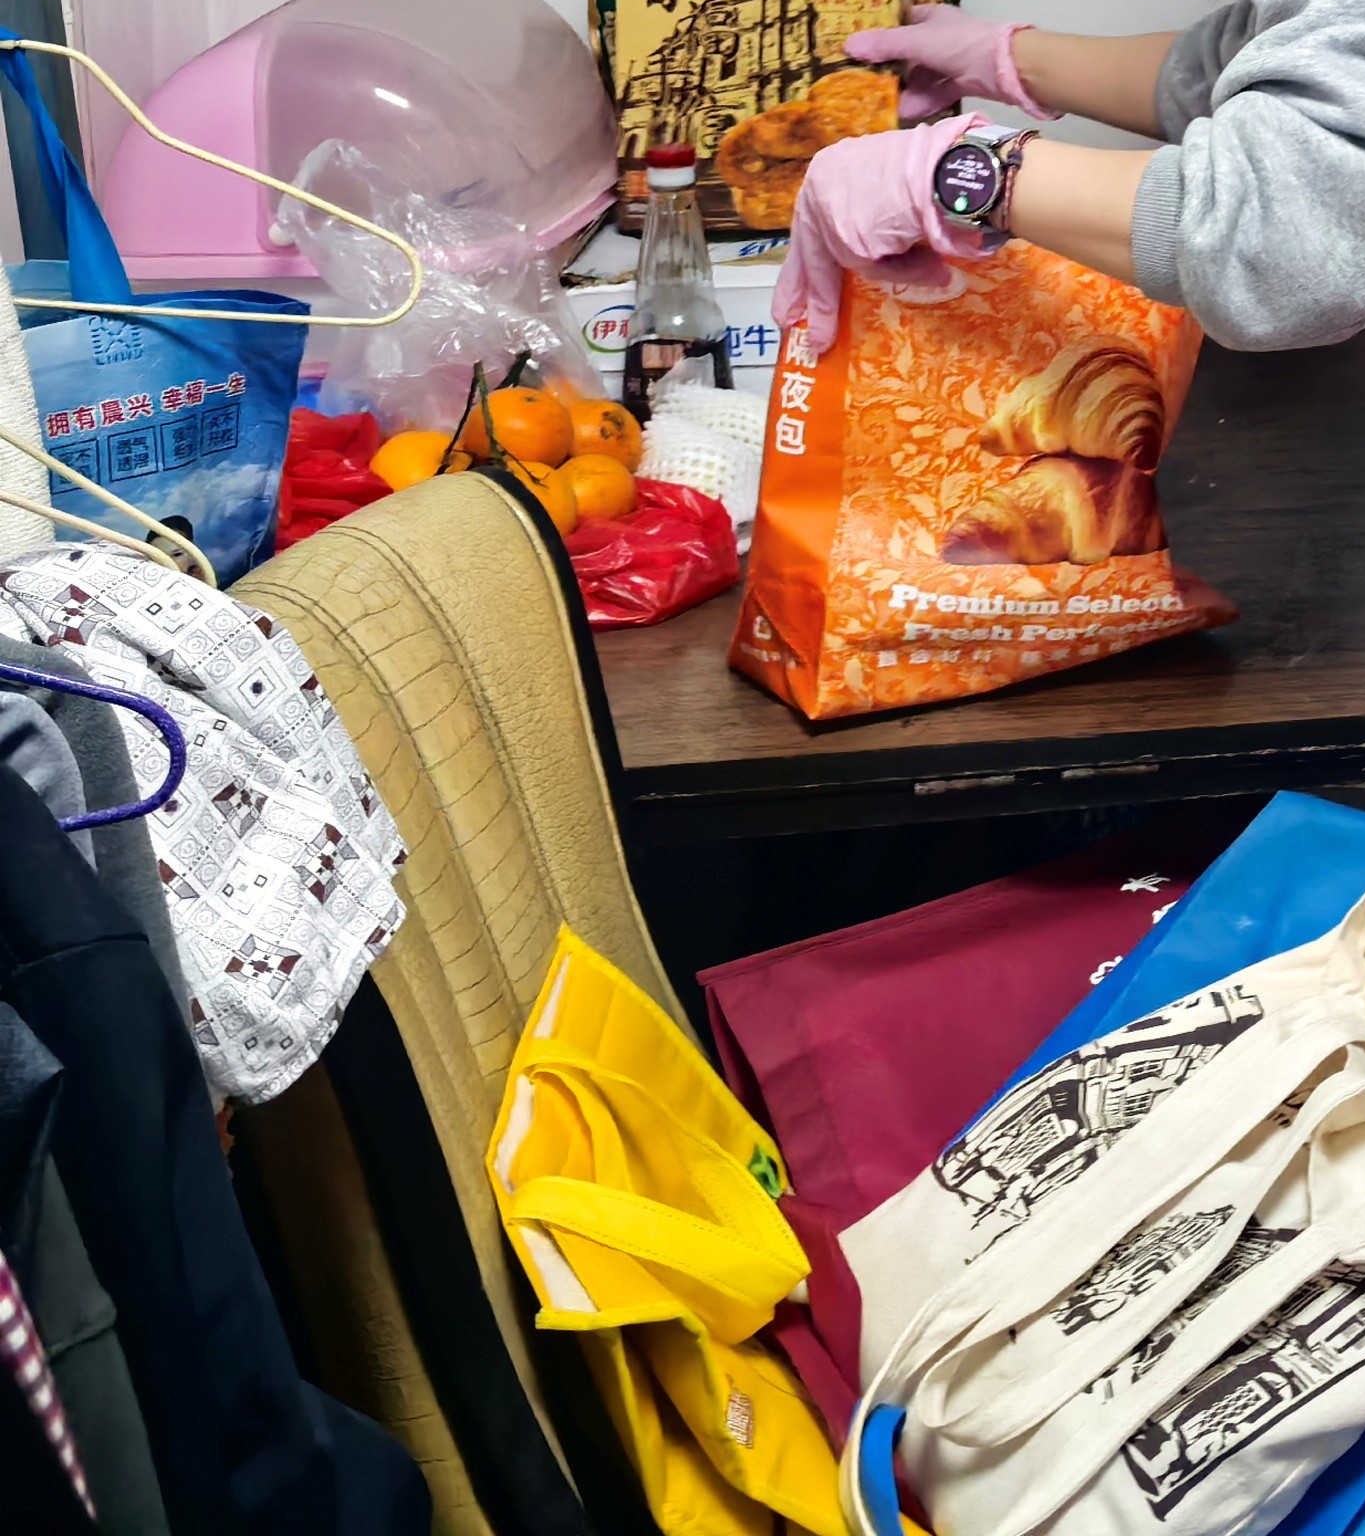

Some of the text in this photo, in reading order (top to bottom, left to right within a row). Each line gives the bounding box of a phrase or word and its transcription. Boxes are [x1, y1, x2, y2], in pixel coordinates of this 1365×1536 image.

[46, 371, 248, 438] 拥有晨兴 幸福一生
[775, 326, 823, 455] 隔夜包
[888, 584, 1060, 615] Premium
[903, 622, 1013, 642] Fresh
